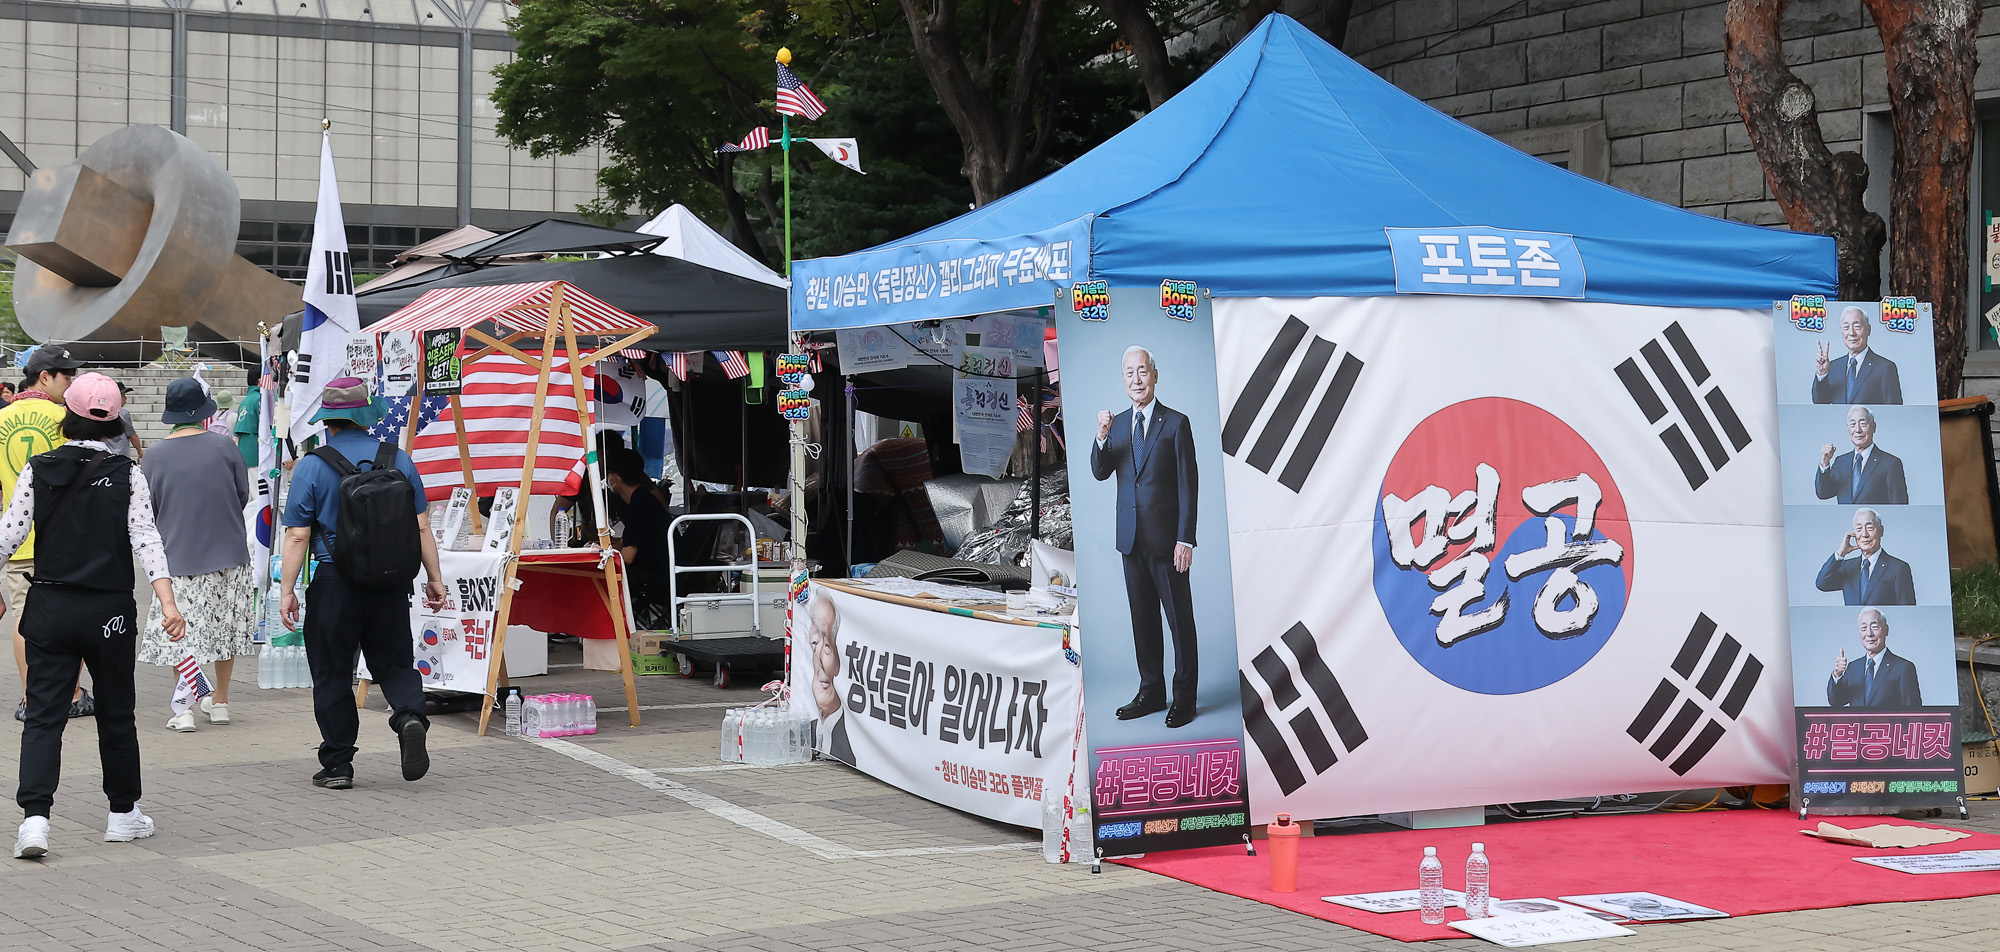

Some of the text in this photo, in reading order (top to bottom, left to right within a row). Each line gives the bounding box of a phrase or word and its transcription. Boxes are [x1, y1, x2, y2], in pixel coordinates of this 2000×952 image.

[1418, 235, 1561, 287] 포토존
[806, 276, 830, 310] 청년
[832, 271, 870, 307] 이승만
[938, 253, 1003, 298] 캘리그라피
[1080, 282, 1106, 294] 이승만
[1169, 282, 1195, 294] 이승만
[1073, 289, 1109, 311] Born
[1162, 286, 1196, 307] Born
[1798, 297, 1823, 308] 이승만
[1889, 298, 1915, 309] 이승만
[1081, 305, 1107, 320] 326
[1168, 305, 1194, 320] 326
[1791, 302, 1826, 320] Born
[1882, 304, 1916, 322] Born
[1798, 317, 1823, 331] 326
[1889, 319, 1914, 332] 326
[784, 355, 808, 364] 이승만
[432, 360, 449, 379] GET!
[784, 389, 808, 399] 이승만
[780, 396, 810, 412] Born
[785, 407, 808, 418] 326
[21, 436, 34, 463] 7
[1382, 462, 1624, 648] 멸공
[1065, 648, 1078, 666] 326
[845, 640, 1048, 759] 청년들아 일어나자
[1804, 722, 1952, 760] #멸공네컷
[941, 759, 959, 784] 청년
[960, 768, 988, 792] 이승만
[989, 772, 1009, 795] 326
[1011, 775, 1044, 802] 플랫폼
[1095, 750, 1241, 806] #멸공네컷
[1803, 780, 1958, 794] #부정선거 #재선거 #당일투표수개표
[1098, 813, 1245, 839] #부정선거 #재선거 #당일투표수개표
